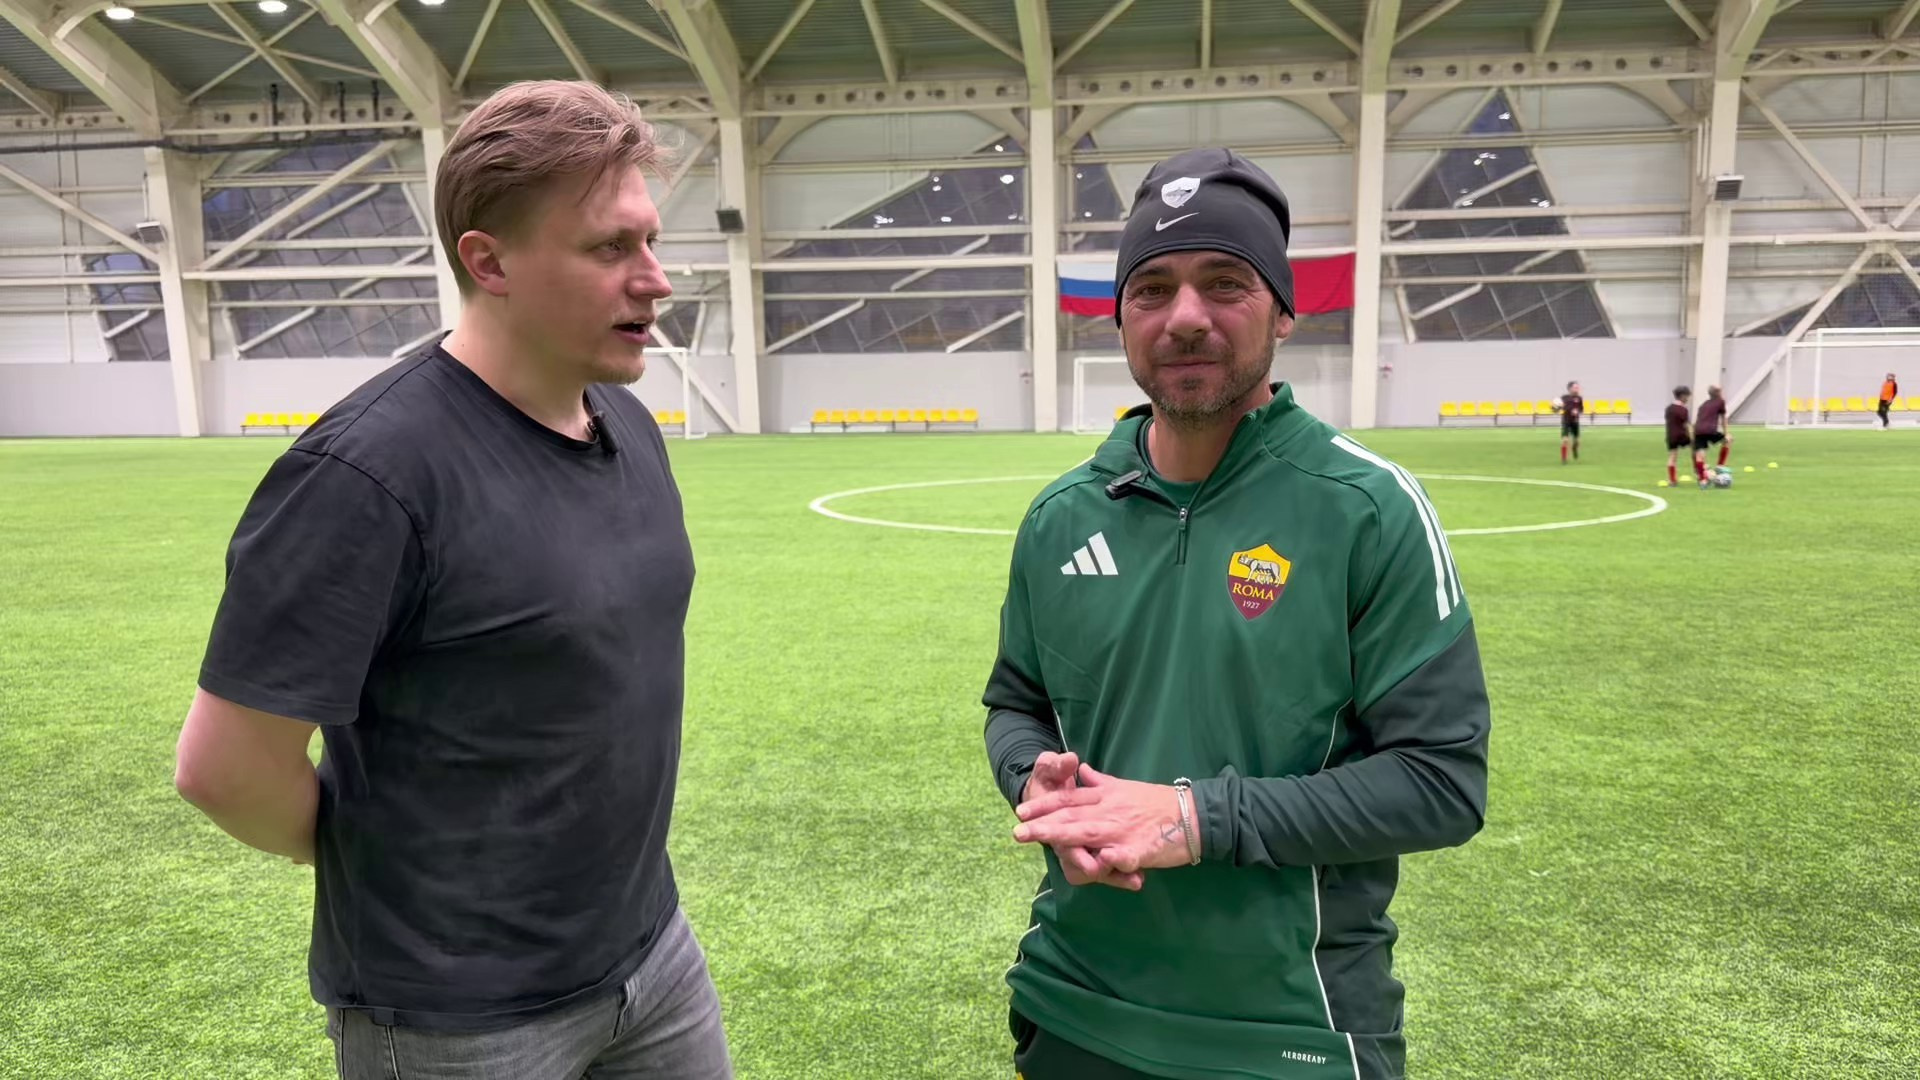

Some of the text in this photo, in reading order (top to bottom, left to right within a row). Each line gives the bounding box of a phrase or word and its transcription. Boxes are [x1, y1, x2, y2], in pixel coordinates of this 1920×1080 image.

[1232, 582, 1274, 601] ROMA
[1242, 600, 1261, 609] 1927
[1281, 1049, 1326, 1065] AEROREADY
